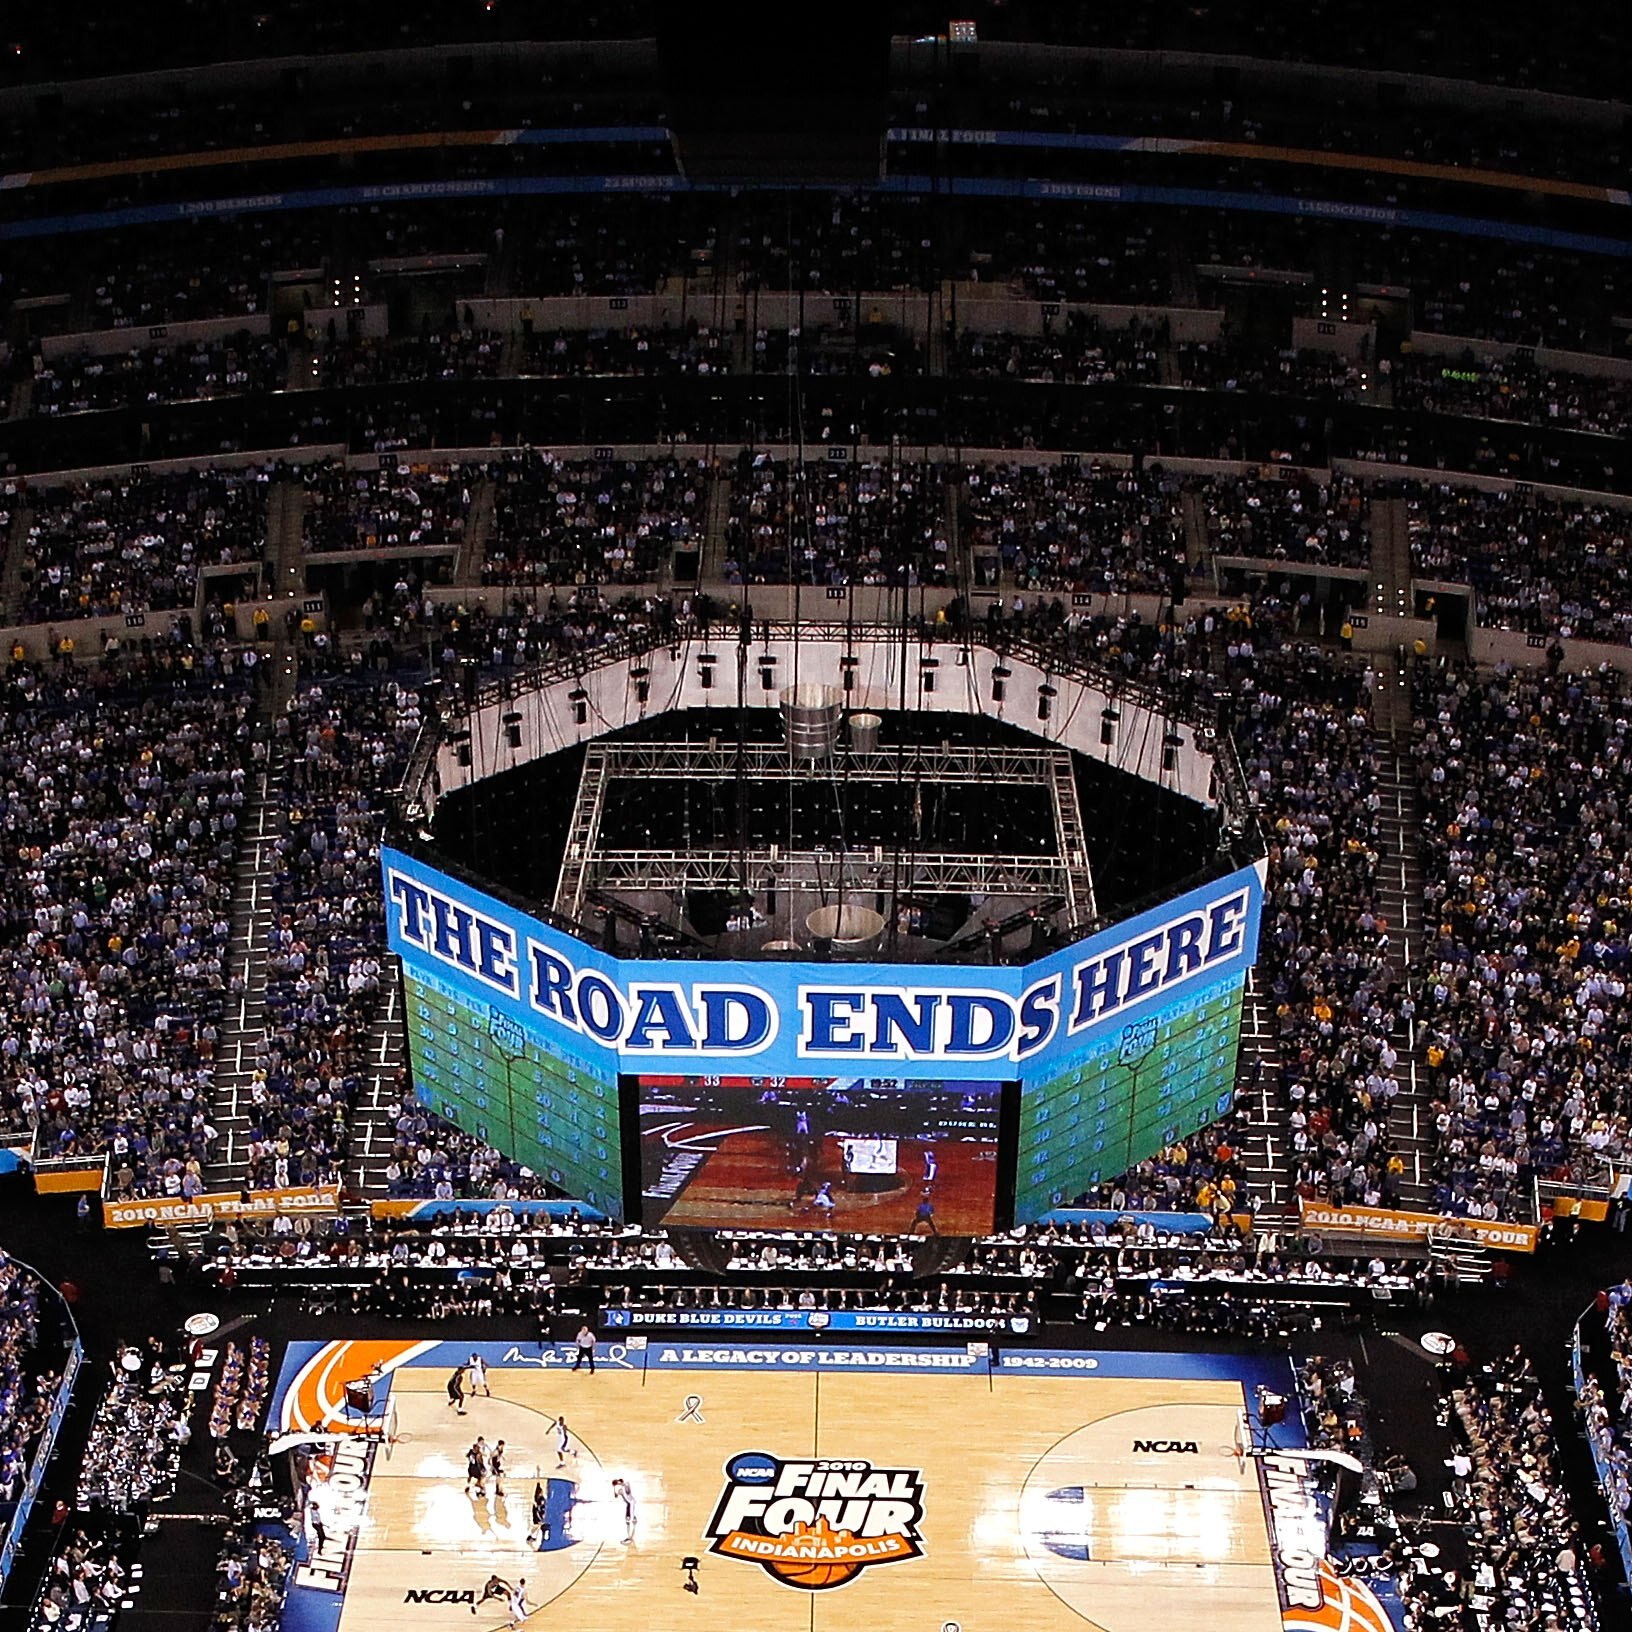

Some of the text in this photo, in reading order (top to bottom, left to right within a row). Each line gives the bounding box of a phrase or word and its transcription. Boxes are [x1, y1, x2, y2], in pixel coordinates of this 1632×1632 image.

[393, 866, 1250, 1062] THE ROAD ENDS HERE
[489, 1021, 525, 1050] FOUR
[704, 1077, 720, 1087] 33
[770, 1077, 786, 1088] 32
[112, 1193, 336, 1223] 2010 NCAA FINAL FOUR
[1305, 1209, 1353, 1225] 2010
[1355, 1214, 1408, 1232] NCAA
[1475, 1229, 1530, 1246] FOUR
[633, 1313, 677, 1325] DUKE
[679, 1314, 721, 1325] BLUE
[723, 1314, 782, 1326] DEVILS
[855, 1316, 919, 1329] BUTLER
[659, 1350, 977, 1368] A LEGACY OF LEADERSHIP
[1002, 1354, 1099, 1370] 1942-2009
[1132, 1441, 1199, 1453] NCAA
[736, 1468, 775, 1477] NCAA
[817, 1461, 868, 1471] 2010
[775, 1463, 915, 1498] FINAL
[715, 1486, 915, 1538] FOUR
[731, 1536, 902, 1559] INDIANAPOLIS
[404, 1590, 474, 1604] NCAA
